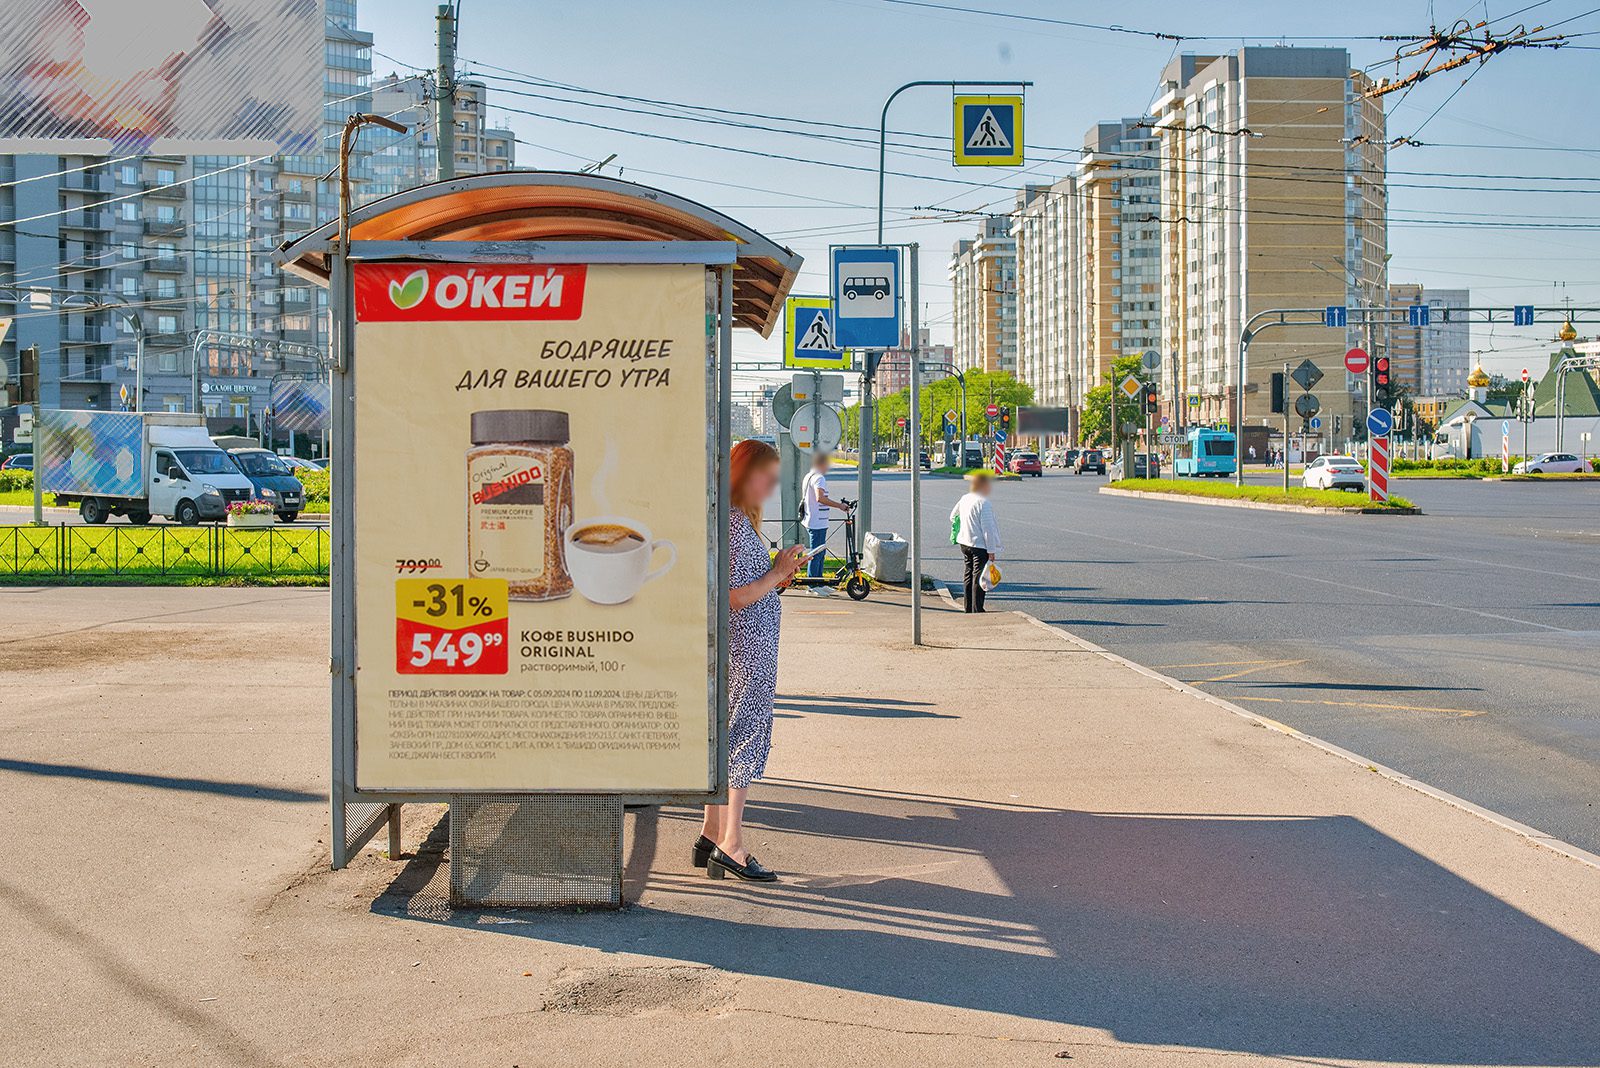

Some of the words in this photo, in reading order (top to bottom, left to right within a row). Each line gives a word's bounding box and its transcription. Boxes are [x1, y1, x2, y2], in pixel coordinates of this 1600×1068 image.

[540, 338, 674, 363] БОДРЯЩЕЕ
[455, 369, 507, 391] ДЛЯ
[514, 369, 612, 390] ВАШЕГО
[619, 368, 671, 388] УТРА
[472, 466, 542, 505] BUSHIDO
[508, 508, 534, 516] COFFEE
[412, 584, 493, 617] -31%
[520, 630, 563, 643] КОФЕ
[568, 630, 634, 643] BUSHIDO
[520, 646, 595, 658] ORIGINAL
[520, 661, 599, 674] растворимый,
[600, 661, 620, 672] 100
[621, 664, 627, 672] г
[388, 689, 418, 698] ПЕРИОД
[419, 689, 457, 698] ДЕЙСТВИЯ
[458, 689, 488, 698] СКИДОК
[489, 689, 500, 698] НА
[527, 689, 532, 698] С
[533, 689, 570, 698] 05.09.2024
[572, 689, 582, 698] ПО
[663, 720, 680, 729] ООО
